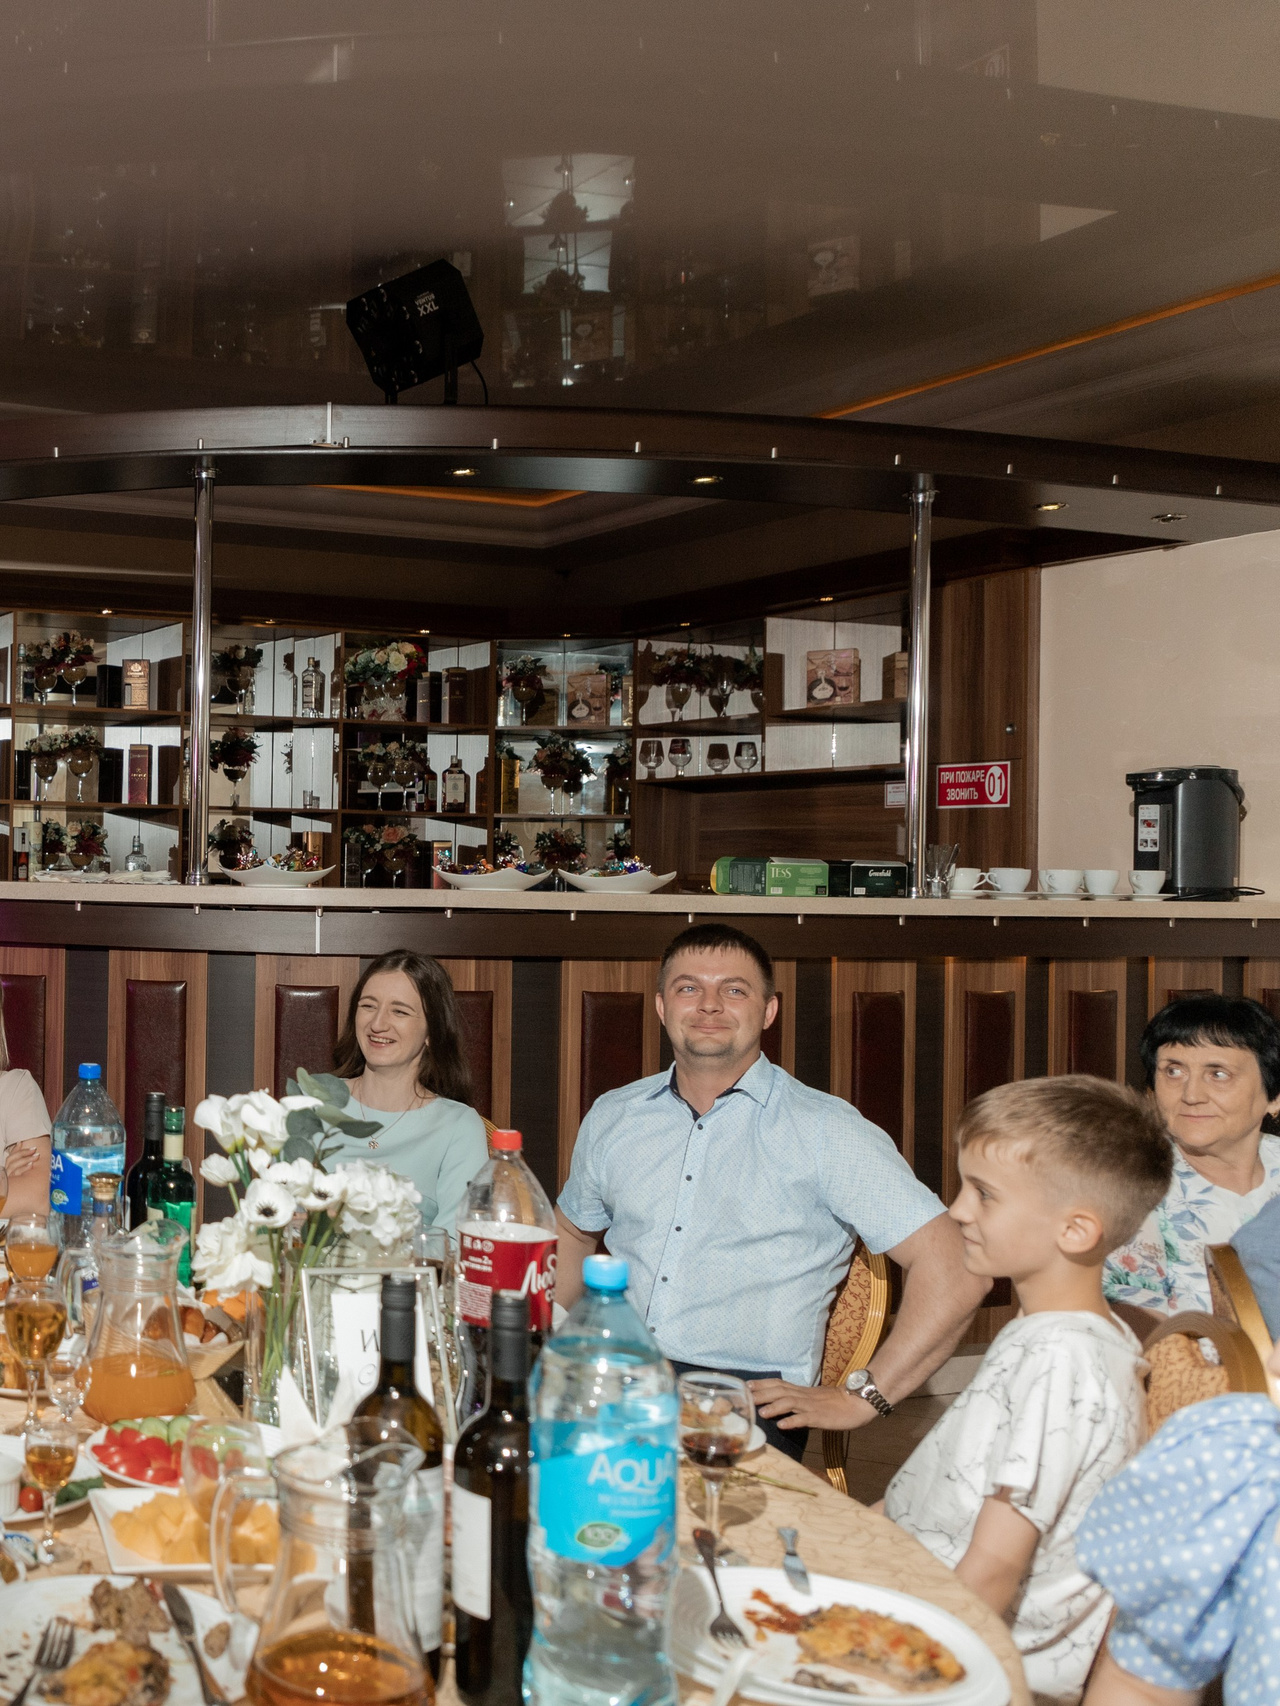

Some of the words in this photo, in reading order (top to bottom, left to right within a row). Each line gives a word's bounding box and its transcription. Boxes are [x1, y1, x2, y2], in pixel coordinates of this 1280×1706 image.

[417, 301, 439, 317] XXL
[940, 771, 955, 784] ПРИ
[955, 769, 985, 783] ПОЖАРЕ
[988, 772, 1003, 797] 01
[946, 787, 978, 801] ЗВОНИТЬ
[770, 867, 792, 879] TESS
